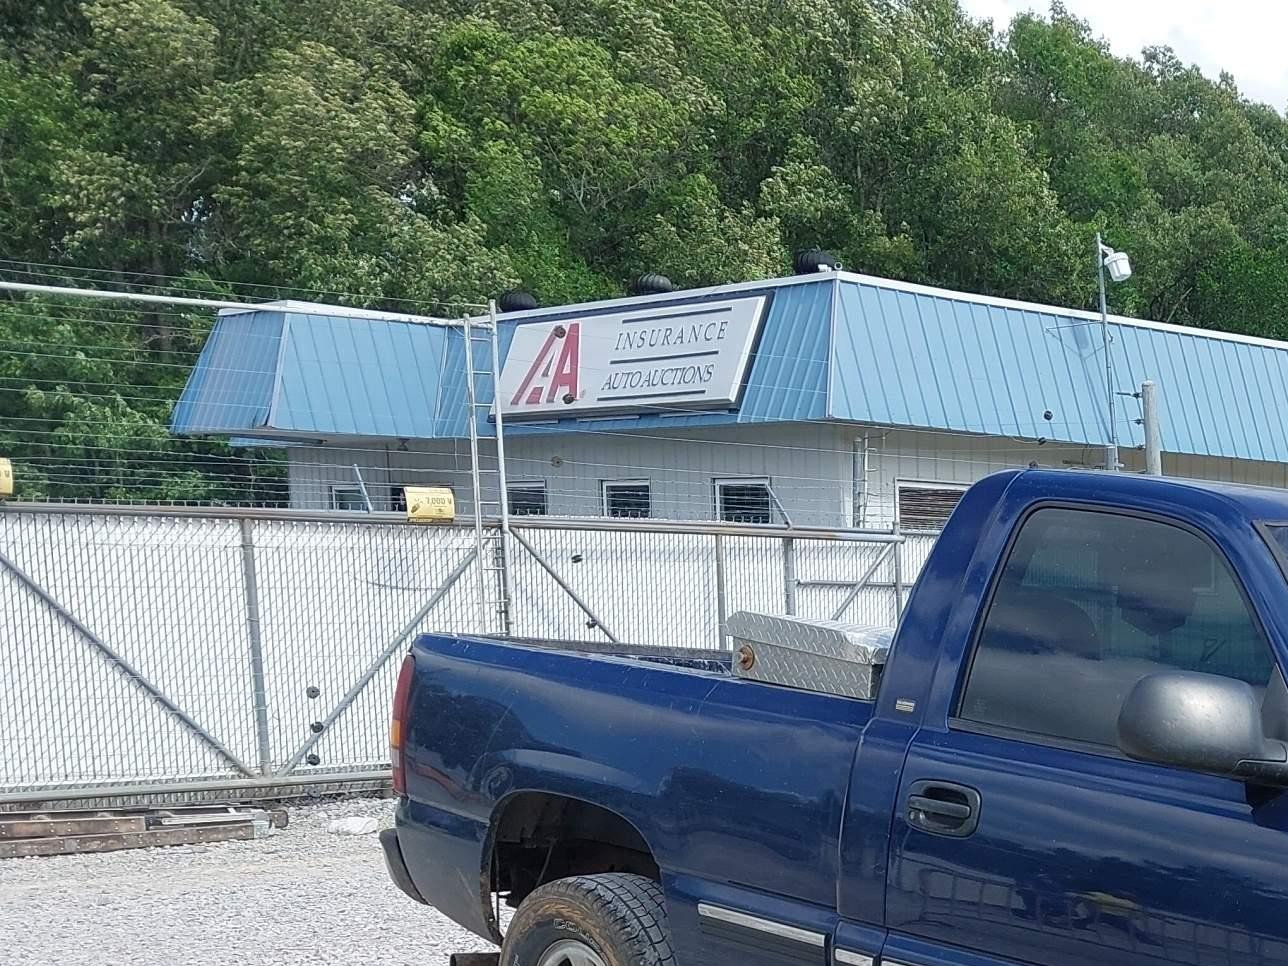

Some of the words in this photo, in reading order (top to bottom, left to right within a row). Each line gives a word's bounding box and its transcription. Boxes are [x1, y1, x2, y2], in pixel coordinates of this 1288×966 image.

[614, 320, 729, 350] INSURANCE
[600, 371, 643, 391] AUTO
[641, 364, 715, 388] AUCTIONS
